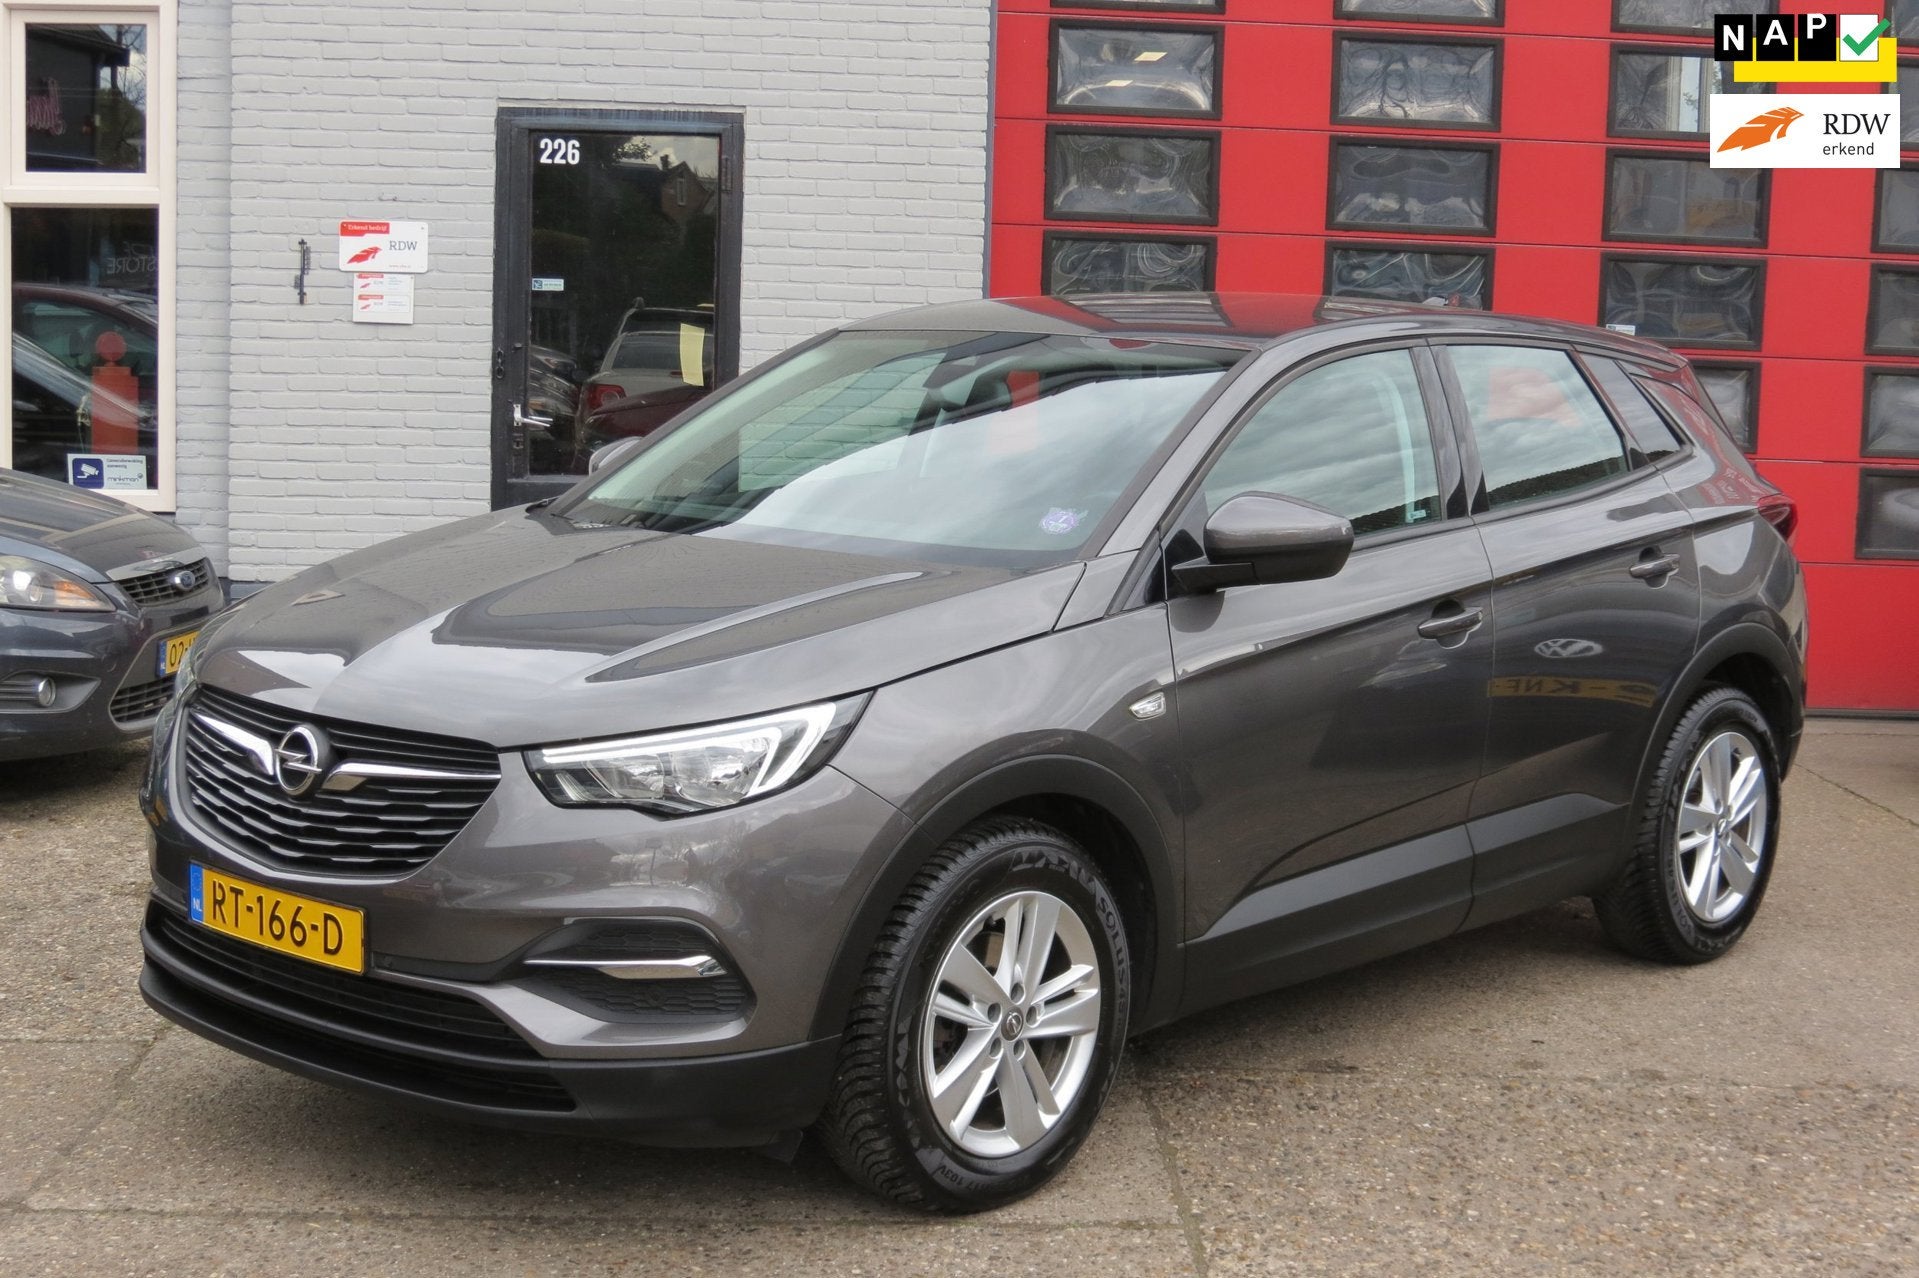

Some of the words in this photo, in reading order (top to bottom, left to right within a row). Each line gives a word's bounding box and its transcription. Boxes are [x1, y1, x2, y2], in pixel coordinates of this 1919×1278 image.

[540, 138, 580, 165] 226
[389, 240, 418, 251] RDW
[212, 879, 343, 955] RT-166-D
[1096, 896, 1126, 983] SOLUS
